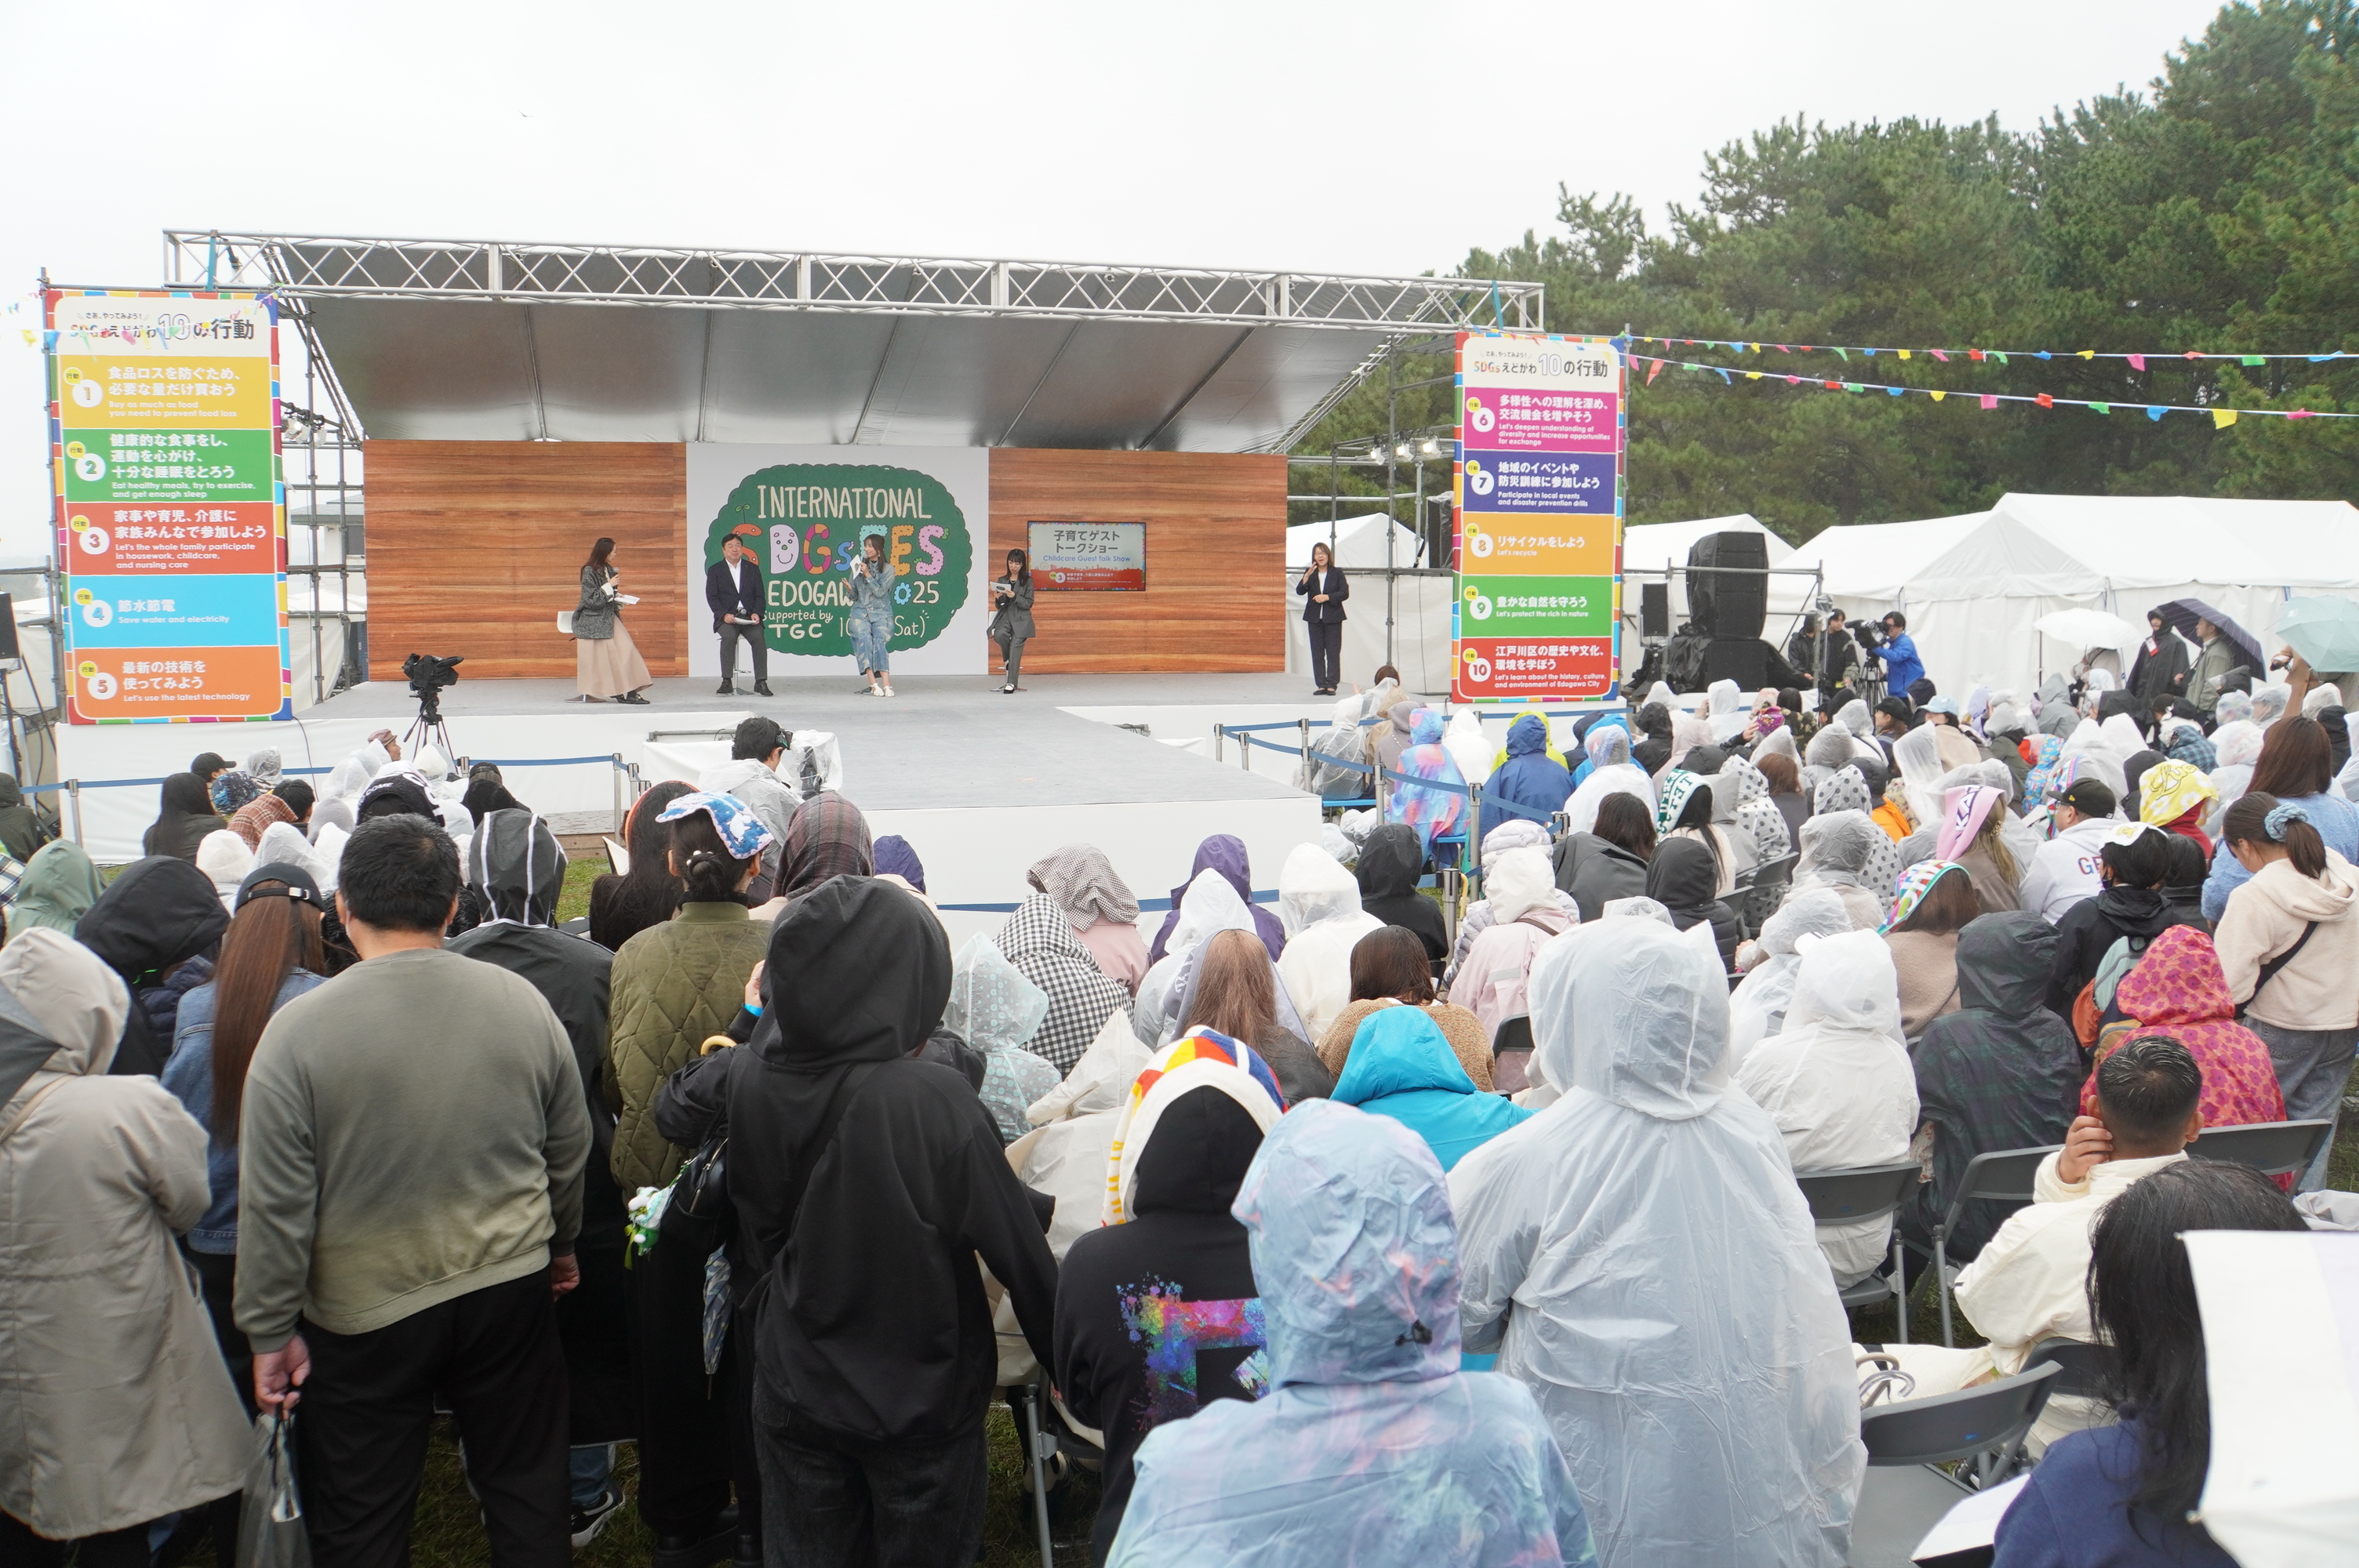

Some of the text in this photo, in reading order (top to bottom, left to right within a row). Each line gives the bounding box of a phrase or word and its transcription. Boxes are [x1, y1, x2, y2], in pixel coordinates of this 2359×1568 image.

[108, 367, 241, 380] 食品ロスを防ぐため、
[84, 387, 90, 400] 1
[109, 383, 235, 396] 必要な量だけ買おう
[1499, 395, 1608, 409] 多様性への理解を深め、
[1480, 415, 1488, 426] 6
[1499, 409, 1592, 423] 交流機会を増やそう
[111, 434, 228, 446] 健康的な食事をし、
[111, 450, 203, 463] 運動を心がけ、
[85, 460, 96, 474] 2
[111, 466, 234, 478] 十分な睡眠をとろう
[1499, 462, 1579, 474] 地域のイベントや
[1479, 477, 1487, 488] 7
[1498, 475, 1600, 489] 防災訓練に参加しよう
[758, 485, 932, 519] INTERNATIONAL
[114, 510, 237, 522] 家事や育児、介護に
[114, 526, 266, 539] 家族みんなで参加しよう
[1054, 530, 1120, 541] 子育てゲスト
[89, 534, 100, 547] 3
[1478, 539, 1486, 551] 8
[1498, 535, 1585, 548] リサイクルをしよう
[180, 543, 206, 551] family
[209, 543, 256, 551] participate
[1056, 543, 1118, 554] トークショー
[768, 580, 853, 607] EDOGAW
[118, 600, 175, 612] 節水節電
[1477, 602, 1485, 613] 9
[1496, 597, 1587, 608] 豊かな自然を守ろう
[93, 608, 104, 620] 4
[819, 609, 834, 623] by
[768, 623, 823, 639] TGC
[1496, 645, 1604, 656] 江戸川区の歴史や文化、
[122, 661, 205, 673] 最新の技術を
[1473, 665, 1487, 676] 10
[1496, 659, 1556, 670] 環境を学ぼう
[97, 680, 107, 693] 5
[123, 677, 203, 690] 使ってみよう
